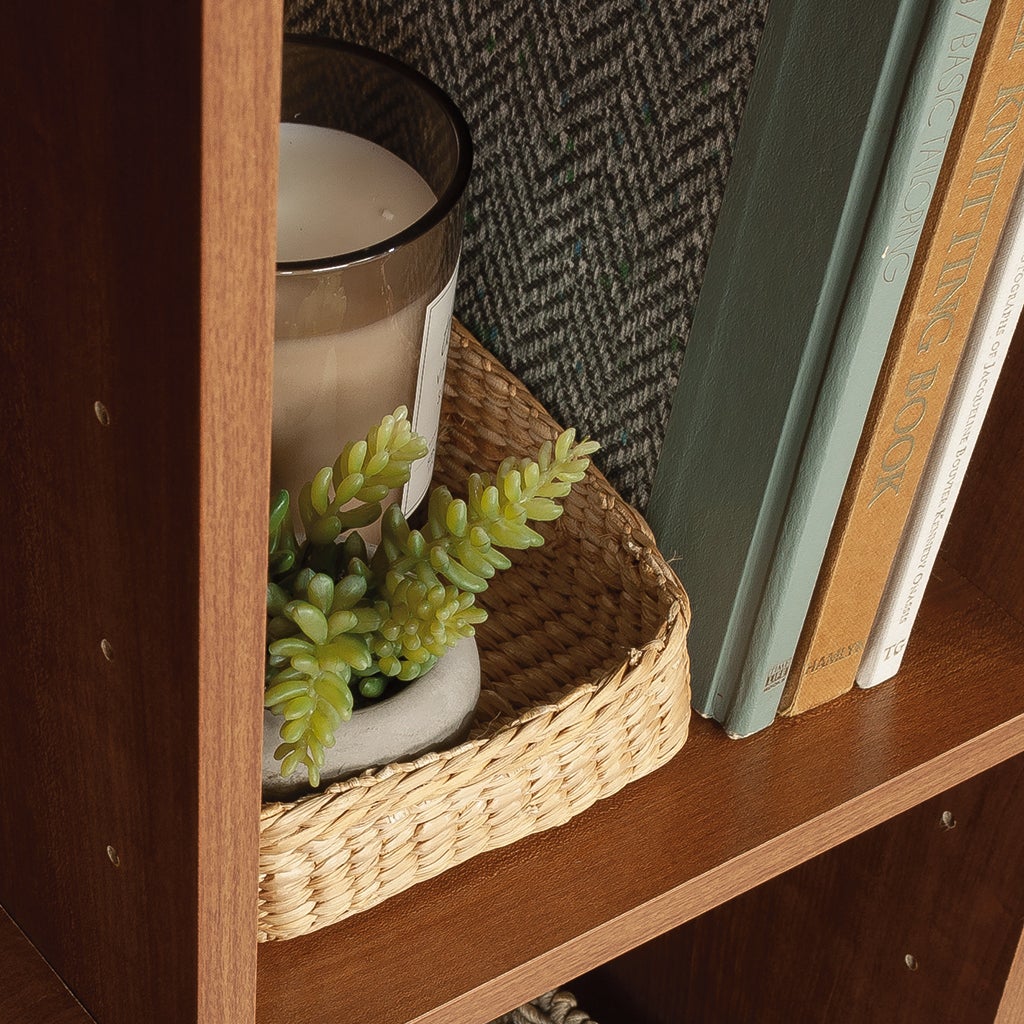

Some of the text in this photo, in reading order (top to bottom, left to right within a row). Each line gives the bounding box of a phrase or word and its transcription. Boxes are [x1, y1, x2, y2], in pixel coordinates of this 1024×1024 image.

[928, 32, 977, 127] BASIC
[883, 130, 950, 283] TAILORING
[867, 83, 1024, 509] KNITTING BOOK
